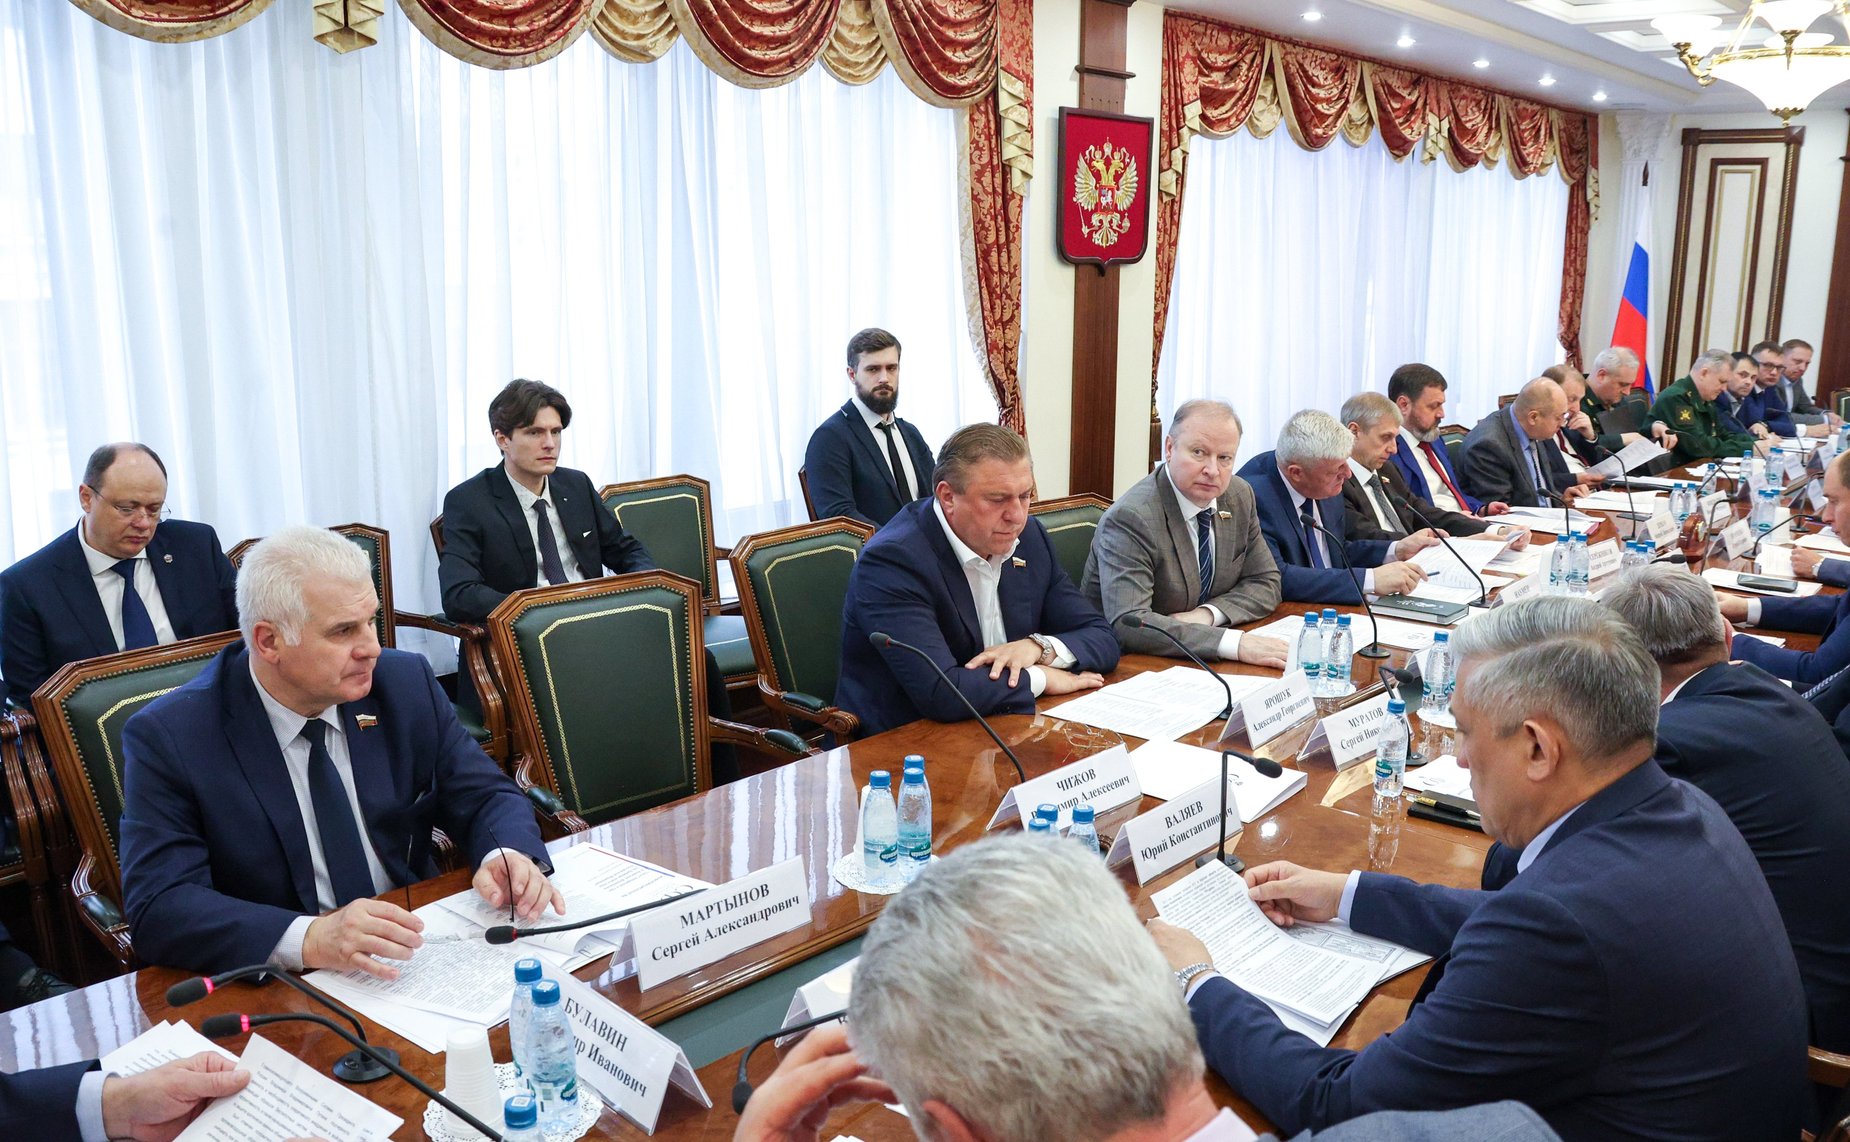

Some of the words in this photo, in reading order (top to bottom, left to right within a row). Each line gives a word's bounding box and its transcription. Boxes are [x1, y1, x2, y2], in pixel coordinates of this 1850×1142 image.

[1348, 707, 1384, 729] МУРАТОВ
[1340, 731, 1365, 750] Сергей
[1056, 768, 1097, 792] ЧИЖОВ
[1081, 775, 1131, 803] Алексеевич
[1164, 800, 1204, 829] ВАЛЯЕВ
[1141, 838, 1169, 861] Юрий
[1168, 807, 1233, 847] Константиноч
[680, 883, 770, 929] МАРТЫНОВ
[651, 933, 701, 962] Сергей
[704, 894, 801, 942] Александрович
[564, 996, 629, 1052] БУЛАВИН
[588, 1044, 648, 1099] Иванович
